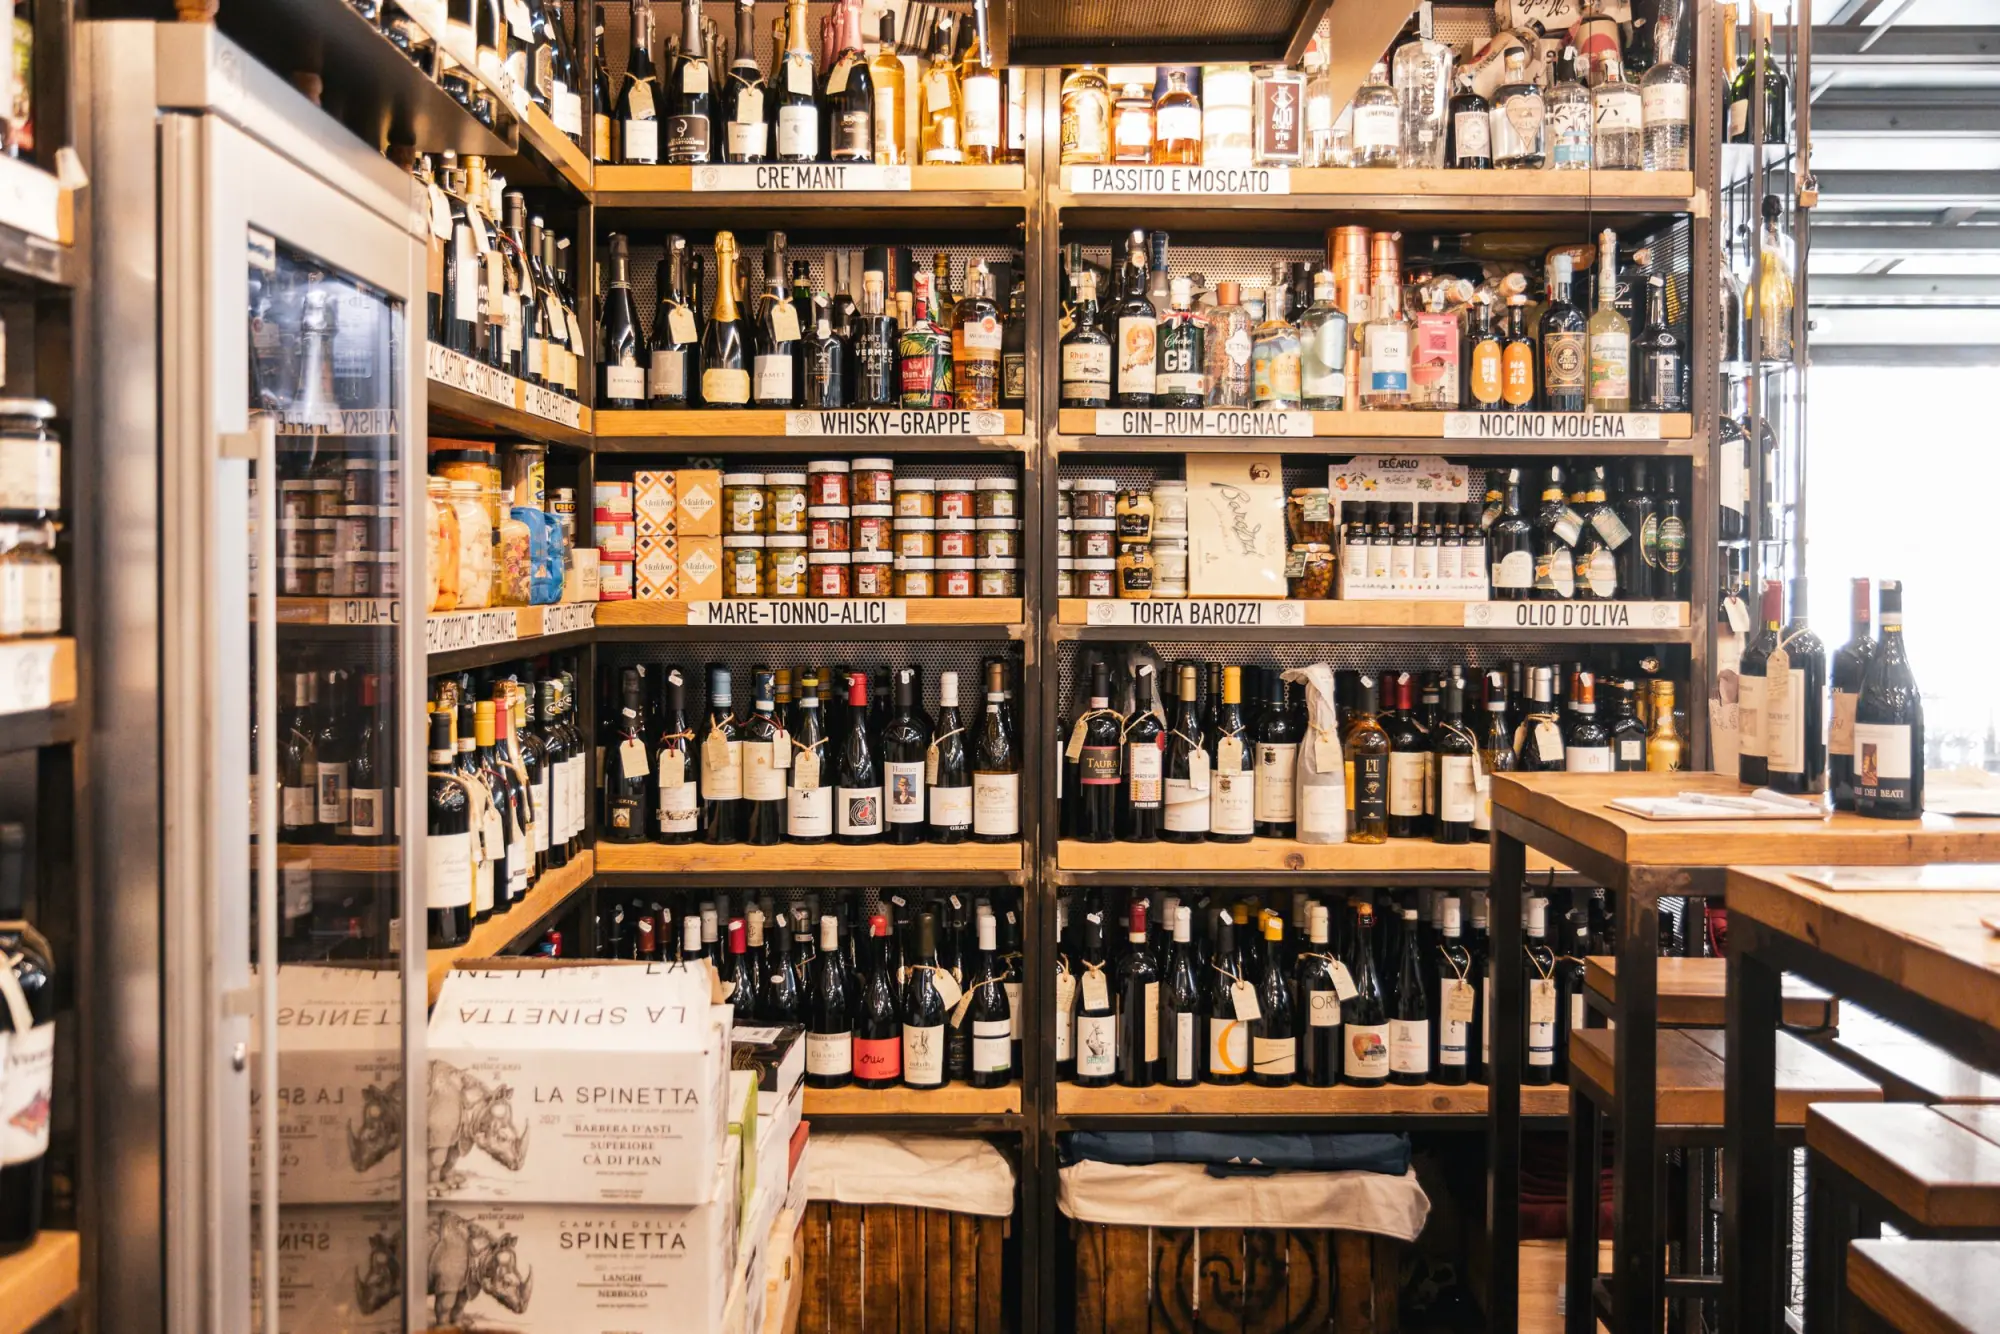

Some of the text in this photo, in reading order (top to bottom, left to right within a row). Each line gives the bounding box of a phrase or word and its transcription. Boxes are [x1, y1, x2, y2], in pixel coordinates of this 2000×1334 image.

[1092, 168, 1270, 193] PASSITO E MOSCATO
[1164, 350, 1192, 372] GB
[820, 411, 971, 435] WHISKY-GRAPPE
[1122, 411, 1288, 435] GIN-RUM-COGNAC
[1479, 414, 1626, 437] NOCINO MODENA
[683, 498, 713, 506] Maldon
[708, 602, 886, 624] MARE-TONNO-ALICI
[1130, 602, 1262, 625] TORTA BAROZZI
[1516, 603, 1629, 626] OLIO D'OLIVA
[1880, 789, 1904, 798] BEATI
[459, 1005, 686, 1025] LA SPINETTA
[534, 1086, 699, 1105] LA SPINETTA
[575, 1124, 672, 1135] BARBERA D'ASTI
[590, 1141, 655, 1151] SUPERIORE
[583, 1153, 662, 1166] CÀ DI PIAN
[632, 1220, 687, 1229] DELLA
[559, 1232, 687, 1250] SPINETTA
[602, 1273, 643, 1283] LANGHE
[597, 1289, 648, 1298] NEBBIOLO
